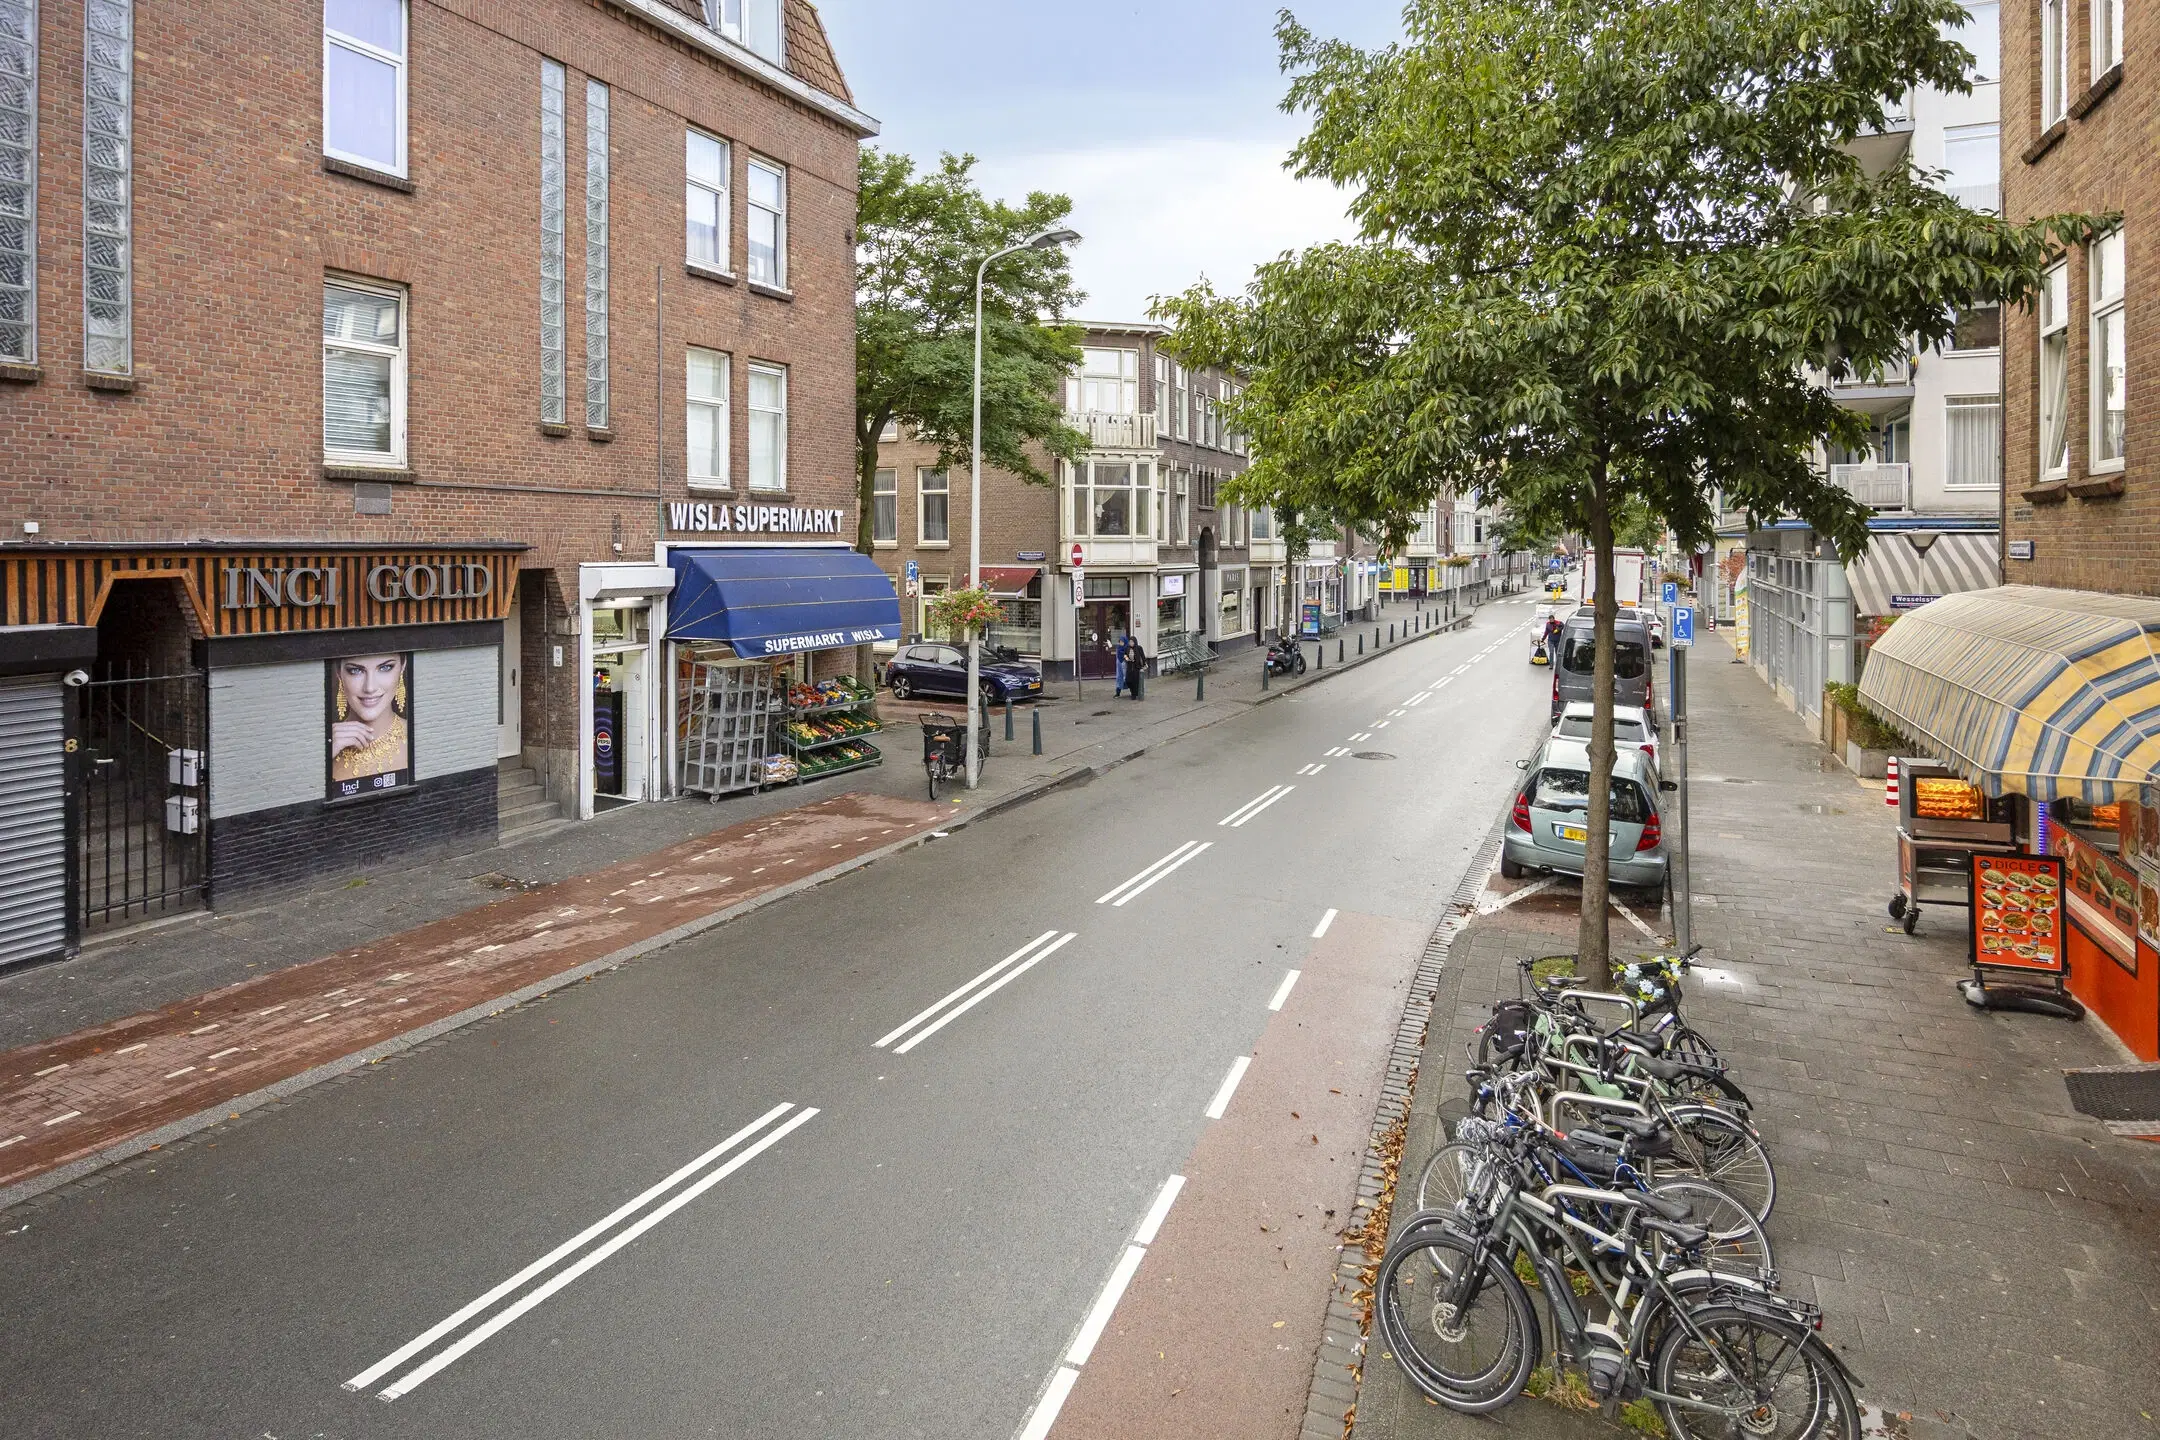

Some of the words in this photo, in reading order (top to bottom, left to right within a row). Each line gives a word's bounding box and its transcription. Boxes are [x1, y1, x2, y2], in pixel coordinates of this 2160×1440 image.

[670, 503, 730, 531] WISLA
[735, 505, 844, 533] SUPERMARKT
[221, 567, 339, 609] INCI
[366, 564, 493, 602] GOLD
[1665, 584, 1673, 594] P
[1676, 609, 1689, 625] P
[765, 632, 845, 653] SUPERMARKT
[851, 628, 885, 642] WISLA
[64, 738, 78, 753] 8
[1995, 861, 2037, 872] DICLE
